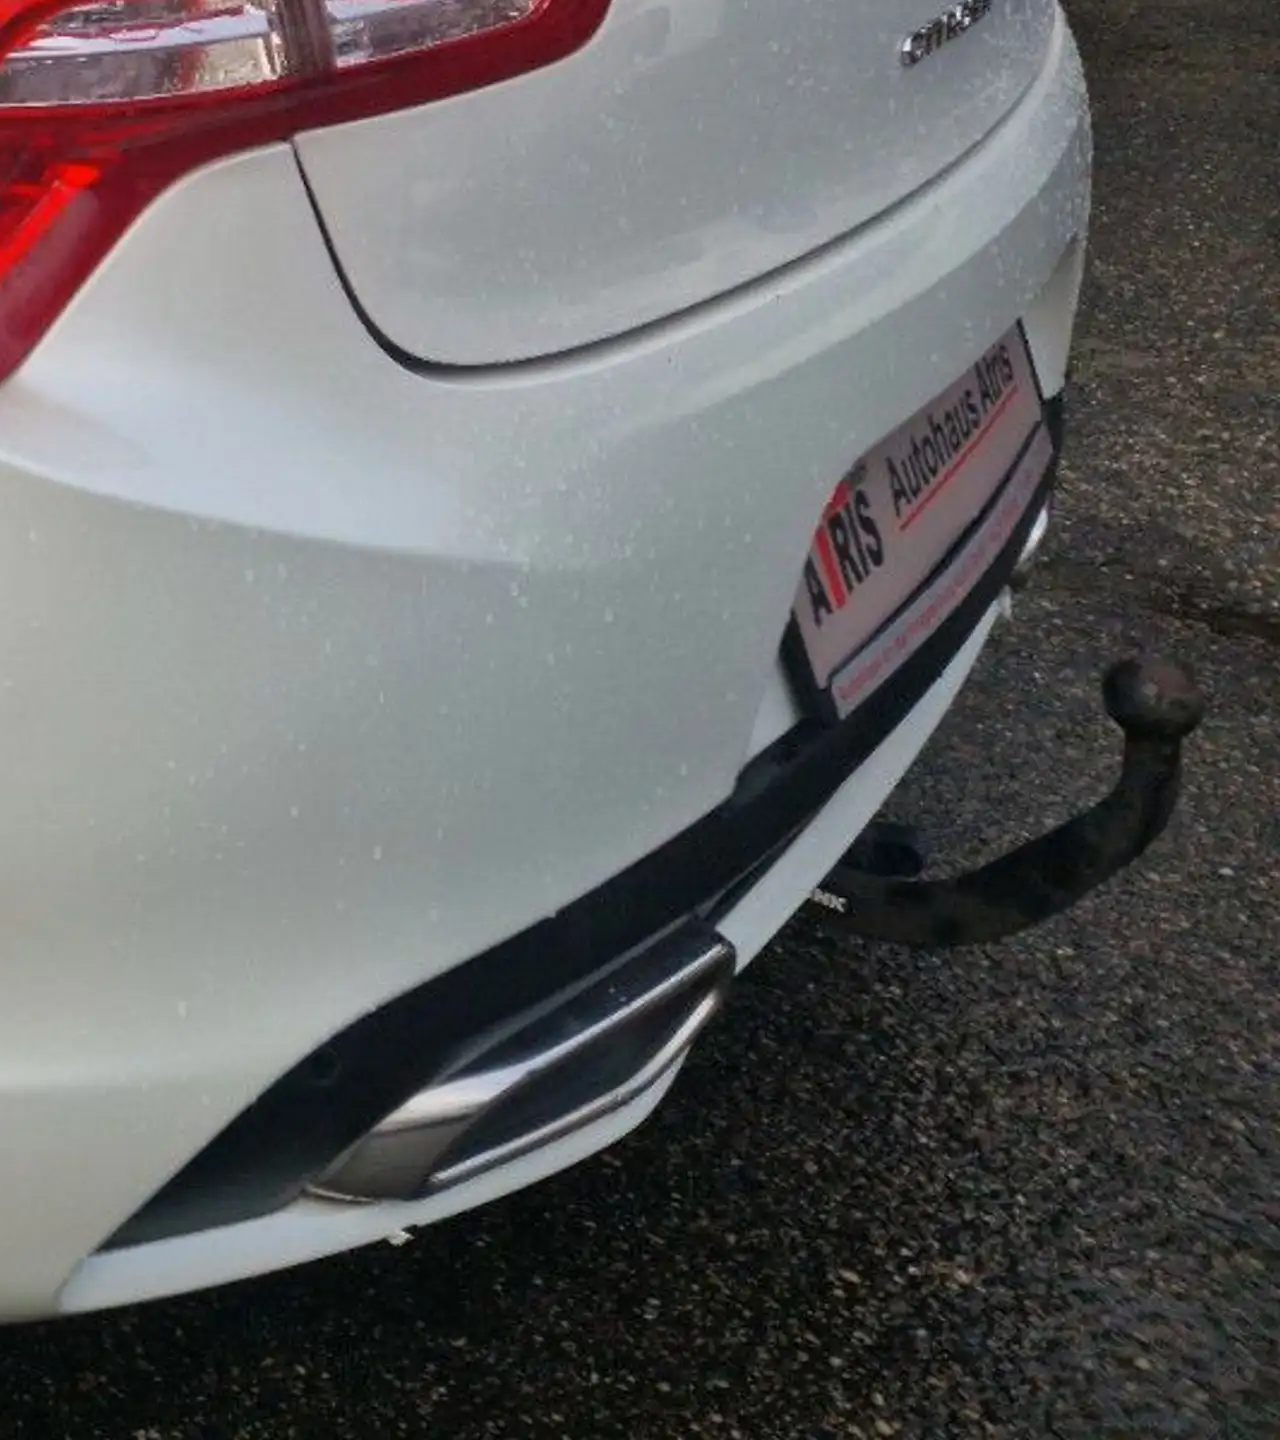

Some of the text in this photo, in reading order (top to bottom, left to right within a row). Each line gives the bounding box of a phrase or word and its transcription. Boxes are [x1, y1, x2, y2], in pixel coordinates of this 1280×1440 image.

[803, 482, 885, 628] ATRIS
[887, 387, 982, 517] Autohaus
[973, 343, 1015, 415] Atris
